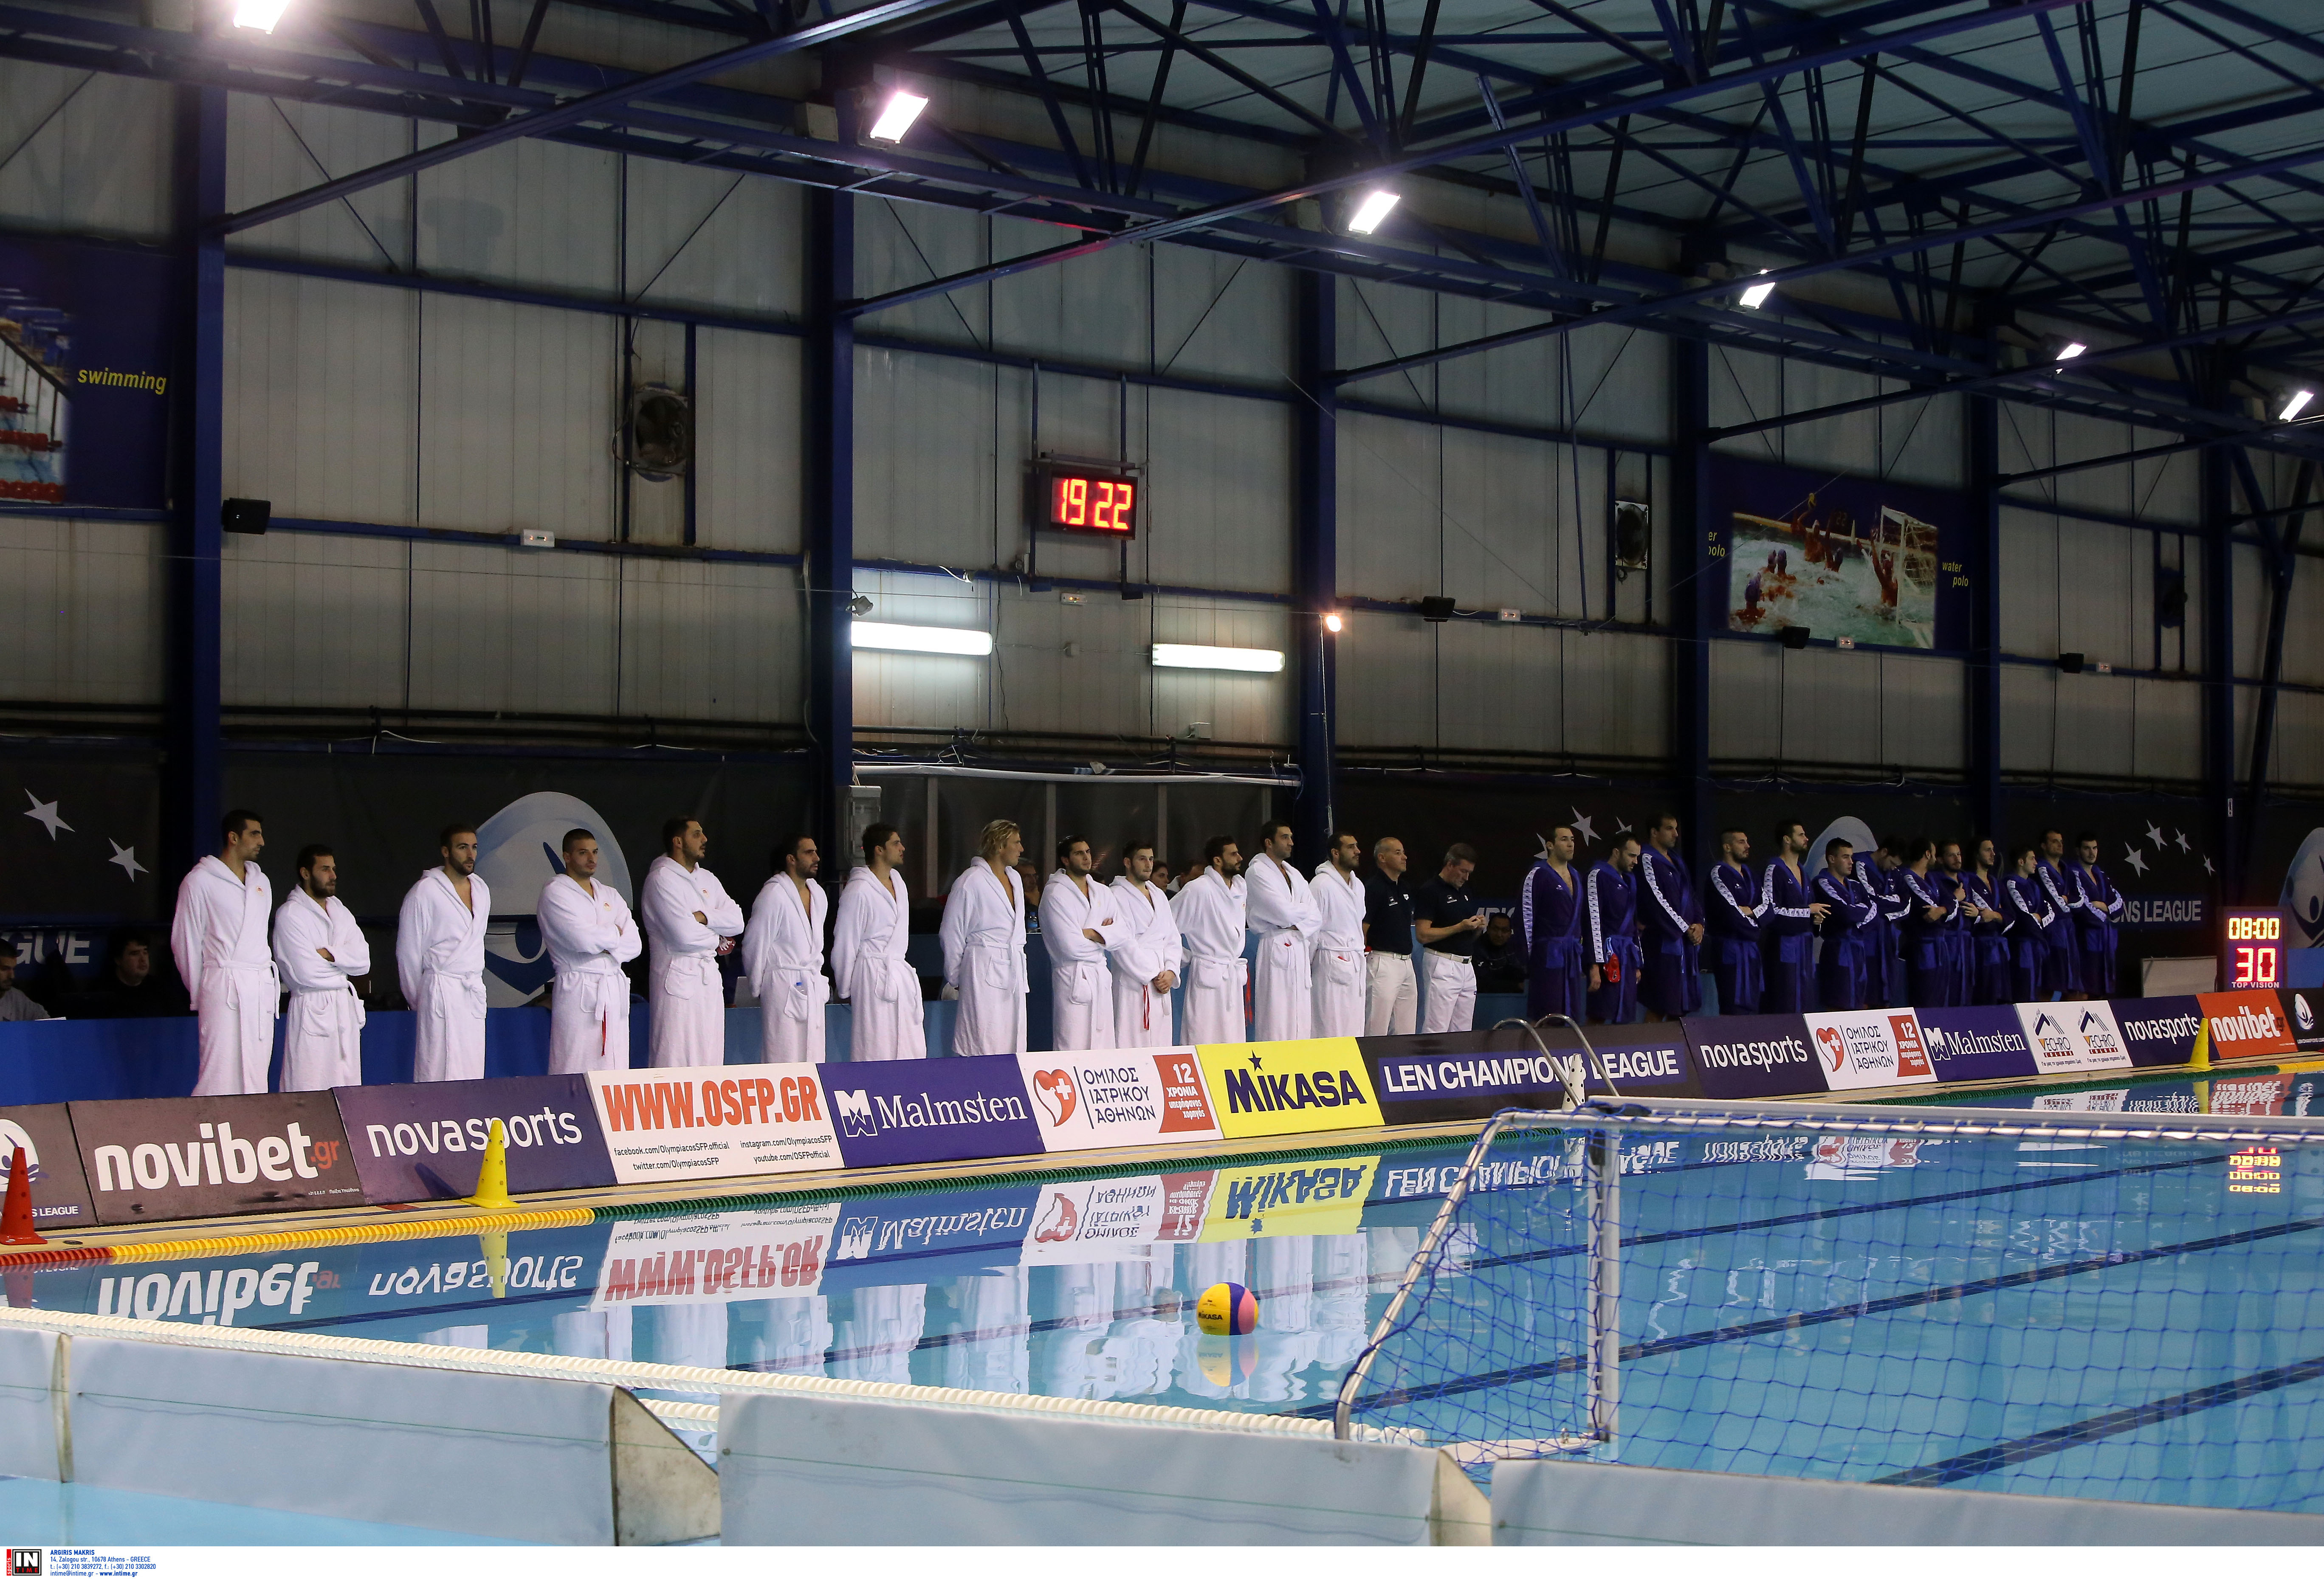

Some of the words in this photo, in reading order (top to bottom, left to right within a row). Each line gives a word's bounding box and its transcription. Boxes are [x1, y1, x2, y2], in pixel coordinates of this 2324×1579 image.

[77, 367, 167, 395] swimming
[1942, 561, 1962, 573] water
[1952, 575, 1968, 588] polo
[2144, 900, 2202, 922] LEAGUE
[2228, 917, 2280, 940] 08:00
[2235, 947, 2277, 982] 30
[1846, 1026, 1881, 1039] ΟΜΙΛΟΣ
[1901, 1022, 1916, 1039] 12
[2124, 1013, 2200, 1044] novasports
[2211, 1005, 2281, 1042] novibet
[1851, 1040, 1889, 1055] ΙΑΤΡΙΚΟΥ
[1944, 1030, 2026, 1055] Malmsten
[1700, 1036, 1808, 1072] novasports
[1856, 1055, 1895, 1070] ΑΘΗΝΩΝ
[1083, 1067, 1139, 1085] ΟΜΙΛΟΣ
[1172, 1063, 1195, 1084] 12
[1384, 1064, 1436, 1093] LEN
[1590, 1050, 1679, 1080] LEAGUE
[1089, 1086, 1148, 1105] ΙΑΤΡΙΚΟΥ
[1166, 1086, 1199, 1098] ΧΡΟΝΙΑ
[1224, 1069, 1367, 1114] MIKASA
[601, 1076, 823, 1132] WWW.OSFP.GR
[873, 1090, 1028, 1129] Malmsten
[1095, 1105, 1156, 1123] ΑΘΗΝΩΝ
[614, 1141, 730, 1156] facebook.com/OlympiacosSFP.official
[740, 1135, 832, 1149] instagram.com/OlympiacosSFP
[633, 1157, 719, 1171] twitter.com/OlympiacosSFP
[753, 1150, 830, 1164] youtube.com/OSFPofficial
[39, 1206, 79, 1216] LEAGUE
